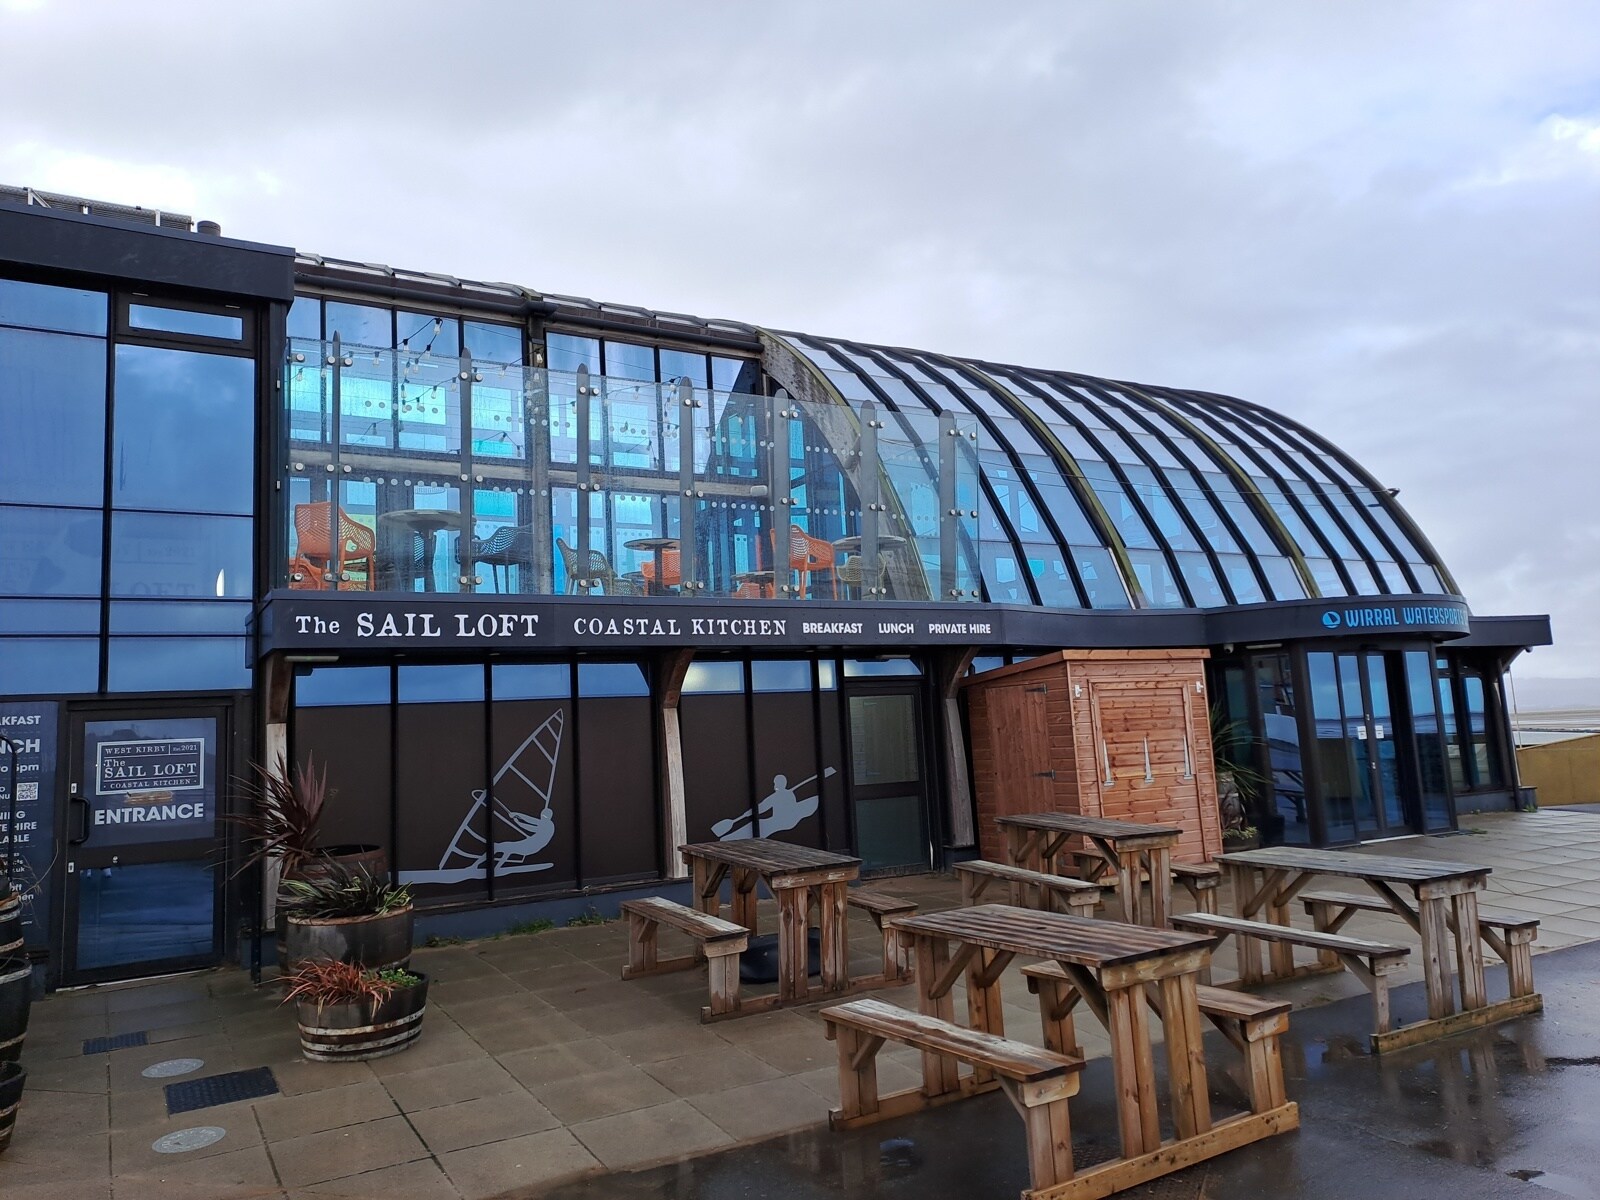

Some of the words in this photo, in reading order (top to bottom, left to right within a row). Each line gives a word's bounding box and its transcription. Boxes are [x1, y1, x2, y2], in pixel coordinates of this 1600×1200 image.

[1345, 607, 1399, 627] WIRRAL
[296, 615, 340, 634] The
[357, 612, 441, 637] SAIL
[454, 613, 539, 637] LOFT
[573, 617, 681, 636] COASTAL
[691, 618, 786, 636] KITCHEN
[802, 622, 863, 634] BREAKFAST
[878, 622, 915, 634] LUNCH
[929, 622, 968, 634] PRIVATE
[969, 622, 991, 634] HIRE
[0, 715, 41, 726] KFAST
[104, 747, 132, 755] WEST
[135, 745, 166, 753] KIRBY
[104, 759, 126, 767] The
[104, 765, 147, 779] SAIL
[154, 763, 197, 776] LOFT
[110, 781, 150, 789] COASTAL
[153, 778, 191, 787] KITCHEN
[94, 803, 204, 825] ENTRANCE
